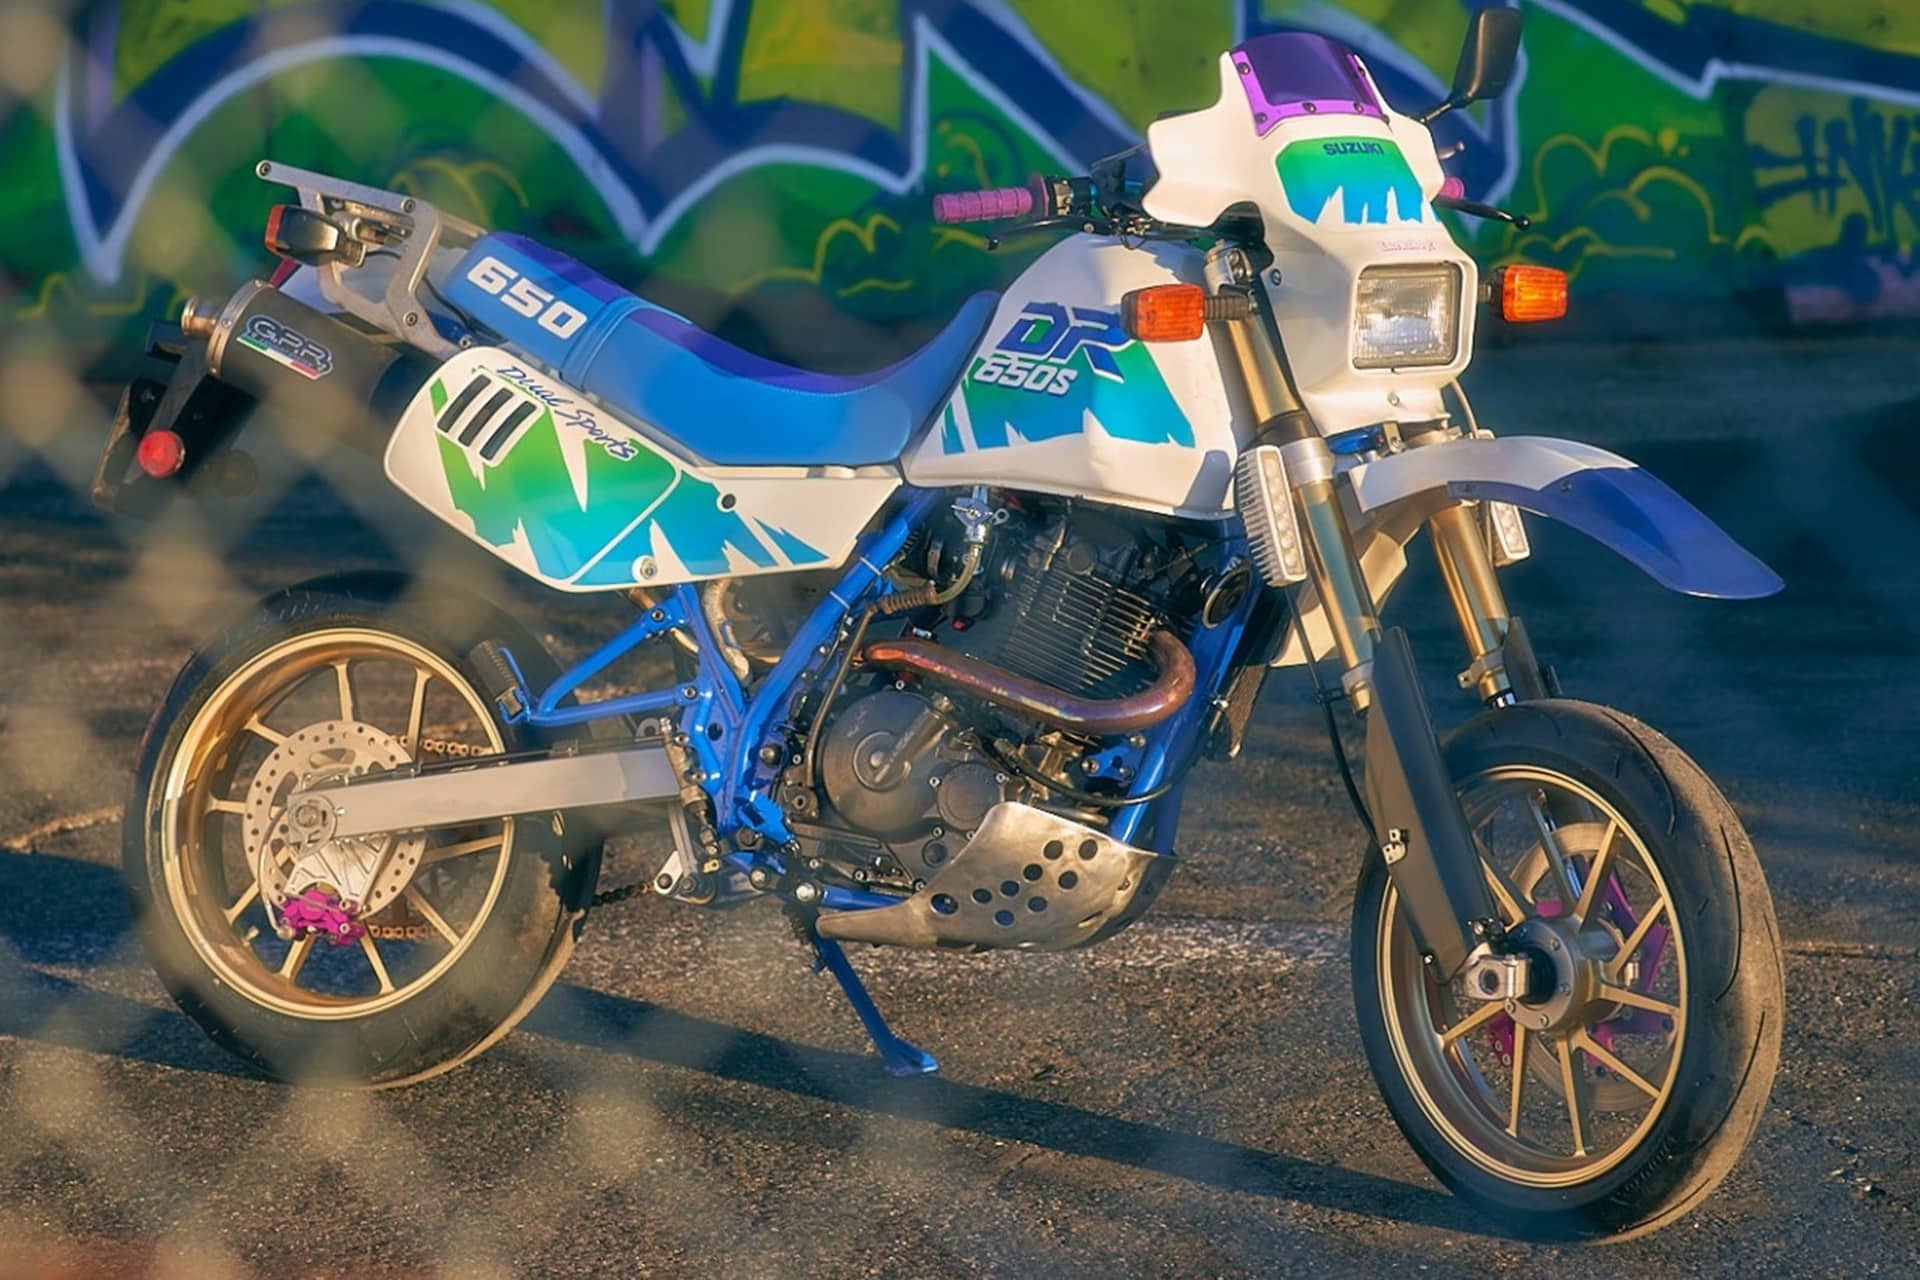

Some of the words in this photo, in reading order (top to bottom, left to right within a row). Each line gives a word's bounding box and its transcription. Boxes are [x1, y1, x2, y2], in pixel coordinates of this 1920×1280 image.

[1322, 141, 1385, 156] SUZUKI
[466, 256, 588, 340] 650
[973, 355, 1078, 396] 650S
[996, 301, 1132, 384] DR
[496, 365, 574, 407] Dual
[554, 408, 636, 459] Sports
